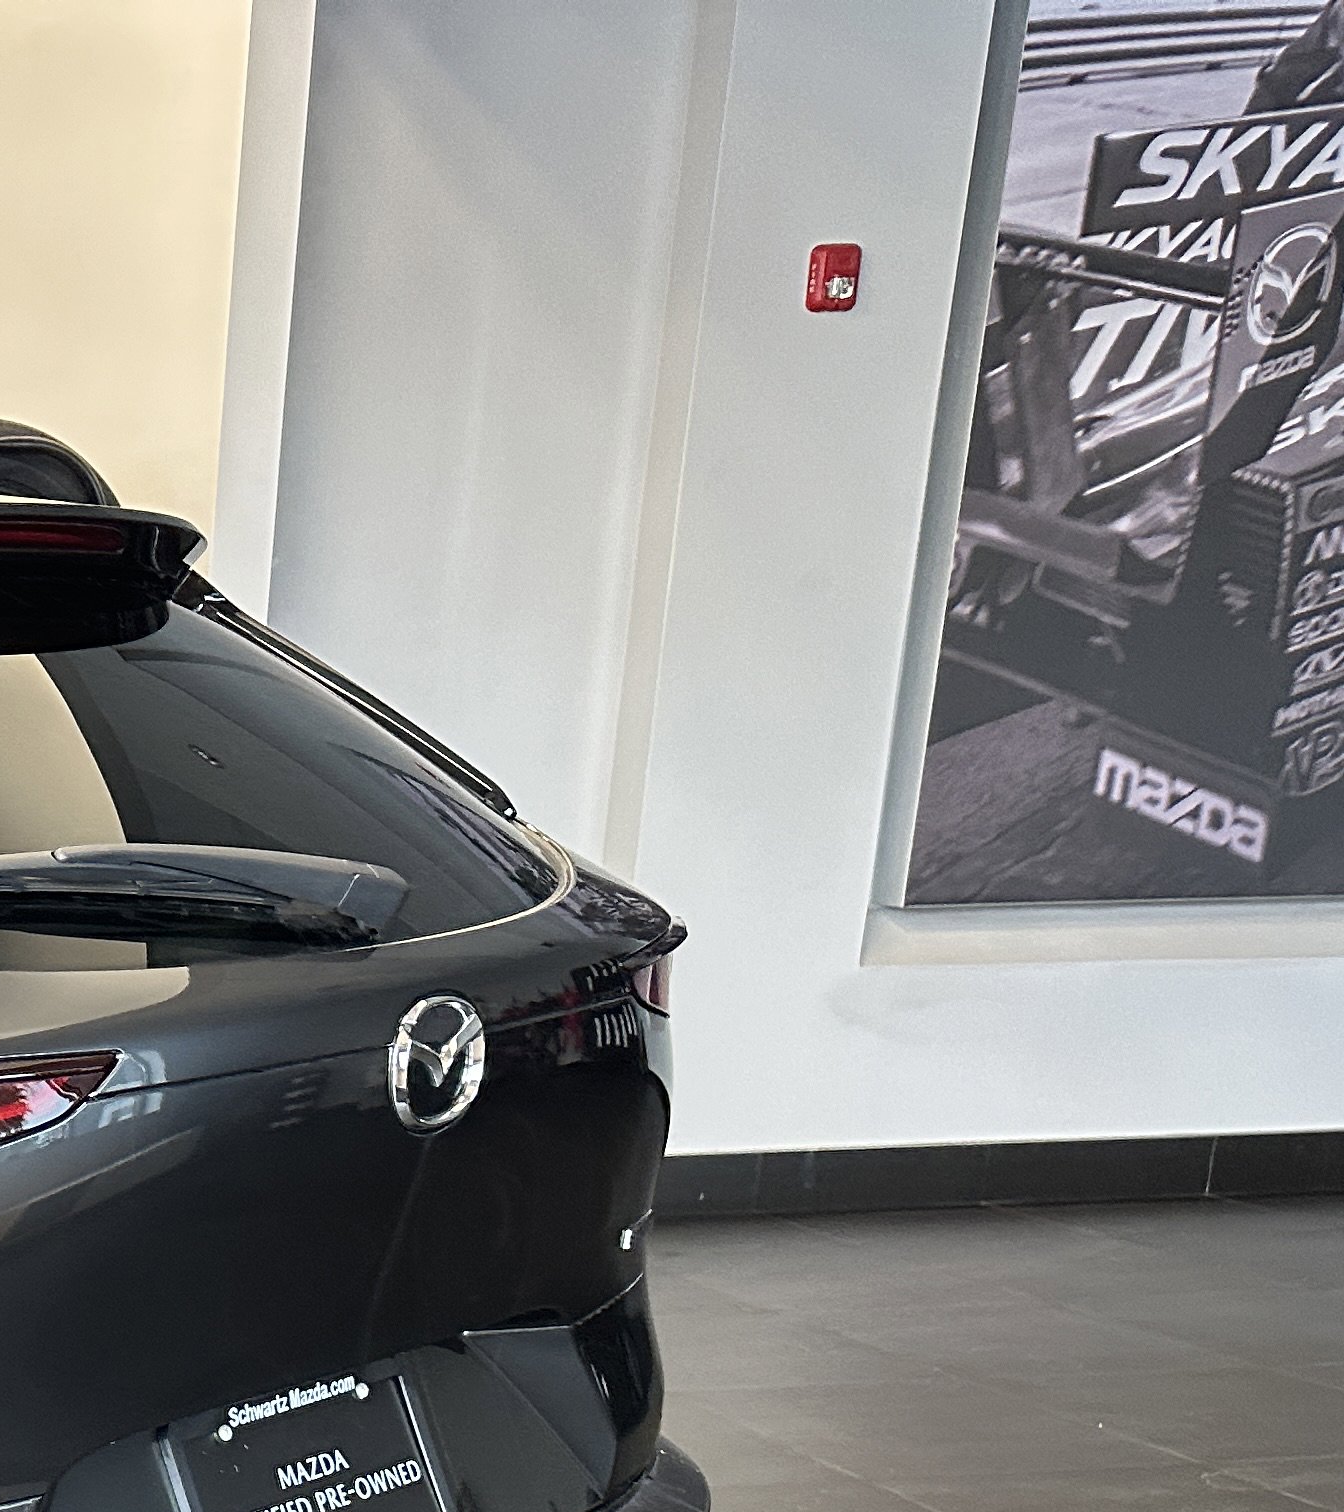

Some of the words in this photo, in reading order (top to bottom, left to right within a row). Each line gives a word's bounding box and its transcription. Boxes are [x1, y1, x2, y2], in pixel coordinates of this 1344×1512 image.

[1092, 748, 1268, 864] mazda
[227, 1394, 290, 1428] Schwartz
[289, 1375, 355, 1409] Mazda.com
[277, 1449, 349, 1490] MAZDA
